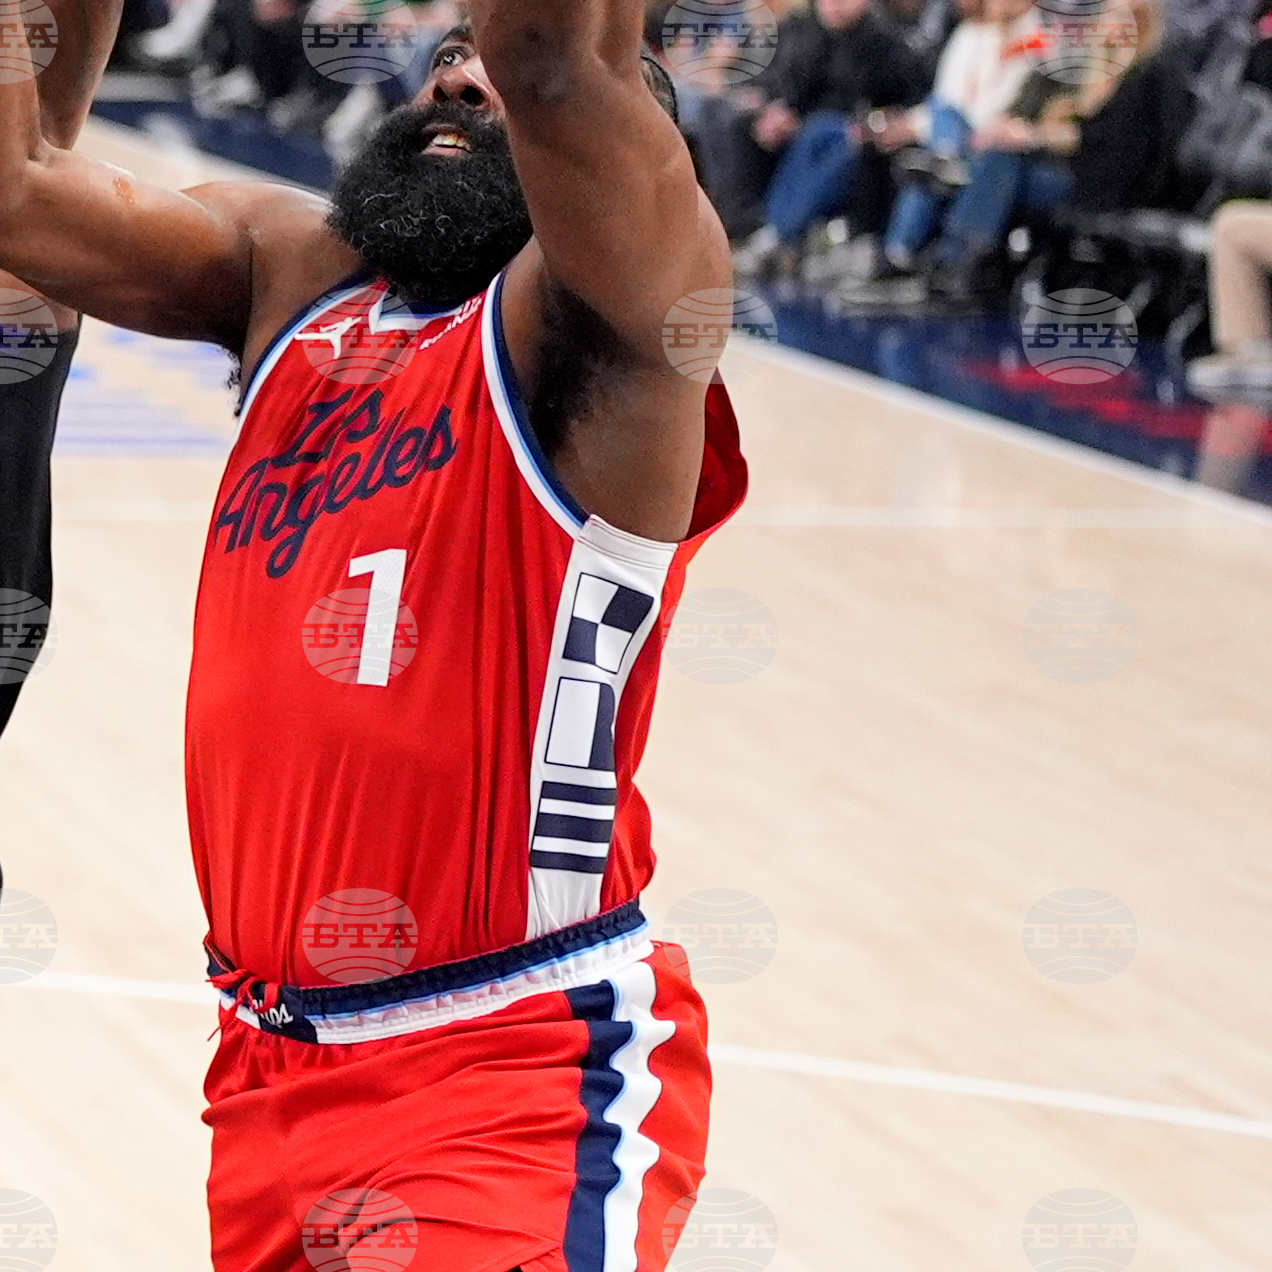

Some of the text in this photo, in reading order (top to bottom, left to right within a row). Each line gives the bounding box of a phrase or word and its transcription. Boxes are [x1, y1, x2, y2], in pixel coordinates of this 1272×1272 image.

[210, 405, 459, 578] Angeles
[270, 388, 384, 468] Ls
[348, 548, 407, 687] 1
